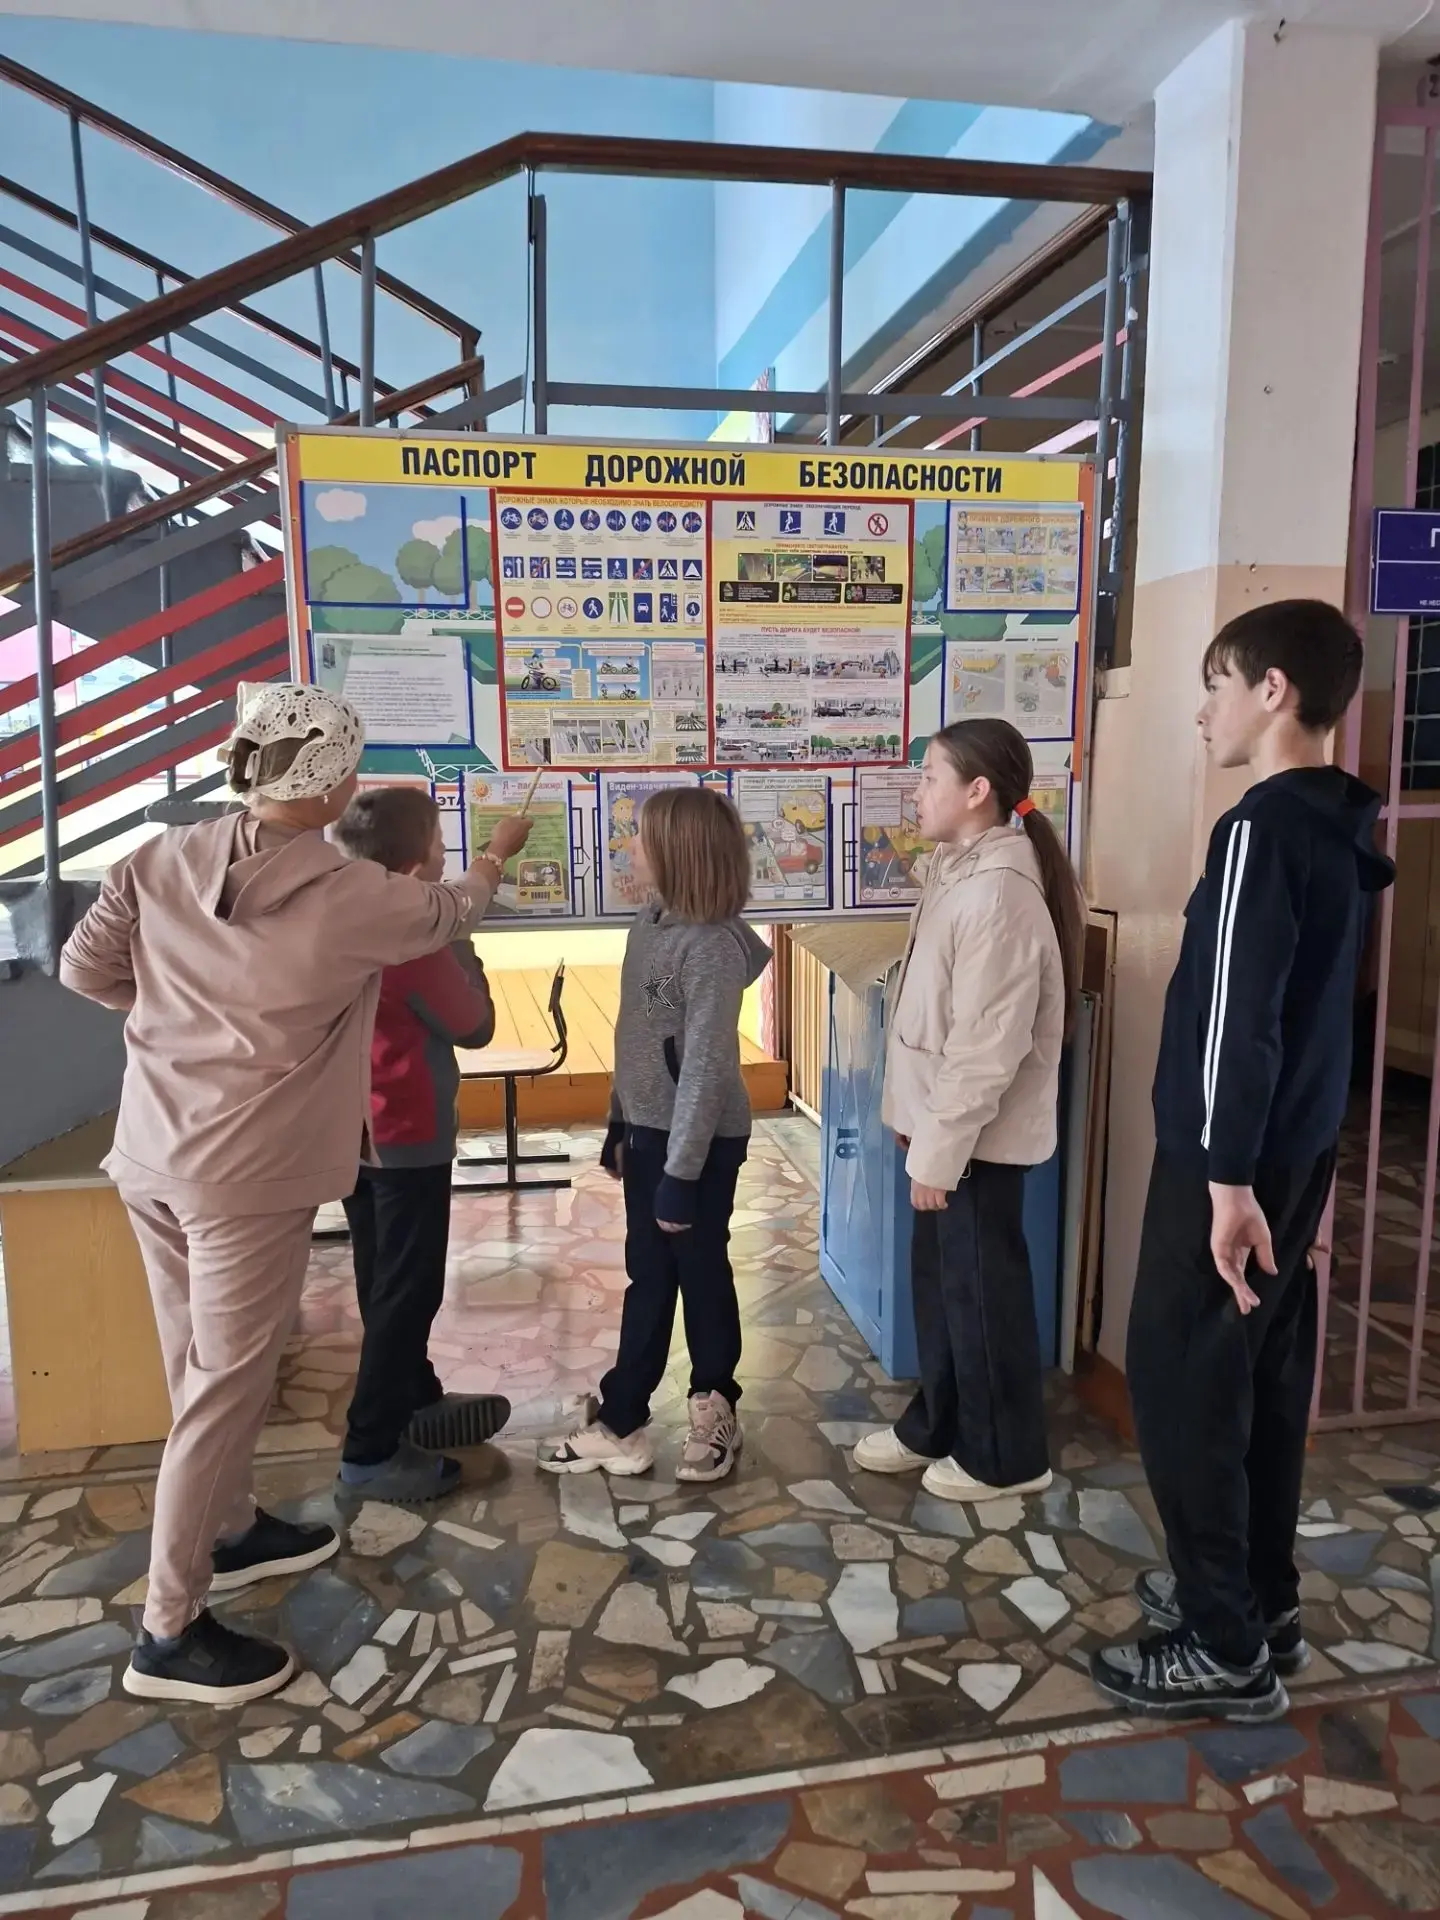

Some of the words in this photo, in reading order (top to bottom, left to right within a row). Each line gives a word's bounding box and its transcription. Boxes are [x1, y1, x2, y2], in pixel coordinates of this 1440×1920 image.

[402, 447, 536, 479] ПАСПОРТ
[585, 453, 745, 487] ДОРОЖНОЙ
[799, 461, 1001, 492] БЕЗОПАСНОСТИ
[498, 496, 534, 504] ДОРОЖНЫЕ
[560, 497, 588, 505] КОТОРЫЕ
[591, 498, 631, 506] НЕОБХОДИМО
[633, 499, 651, 507] ЗНАТЬ
[653, 500, 704, 508] ВЕЛОСИПЕДИСТУ
[502, 781, 509, 790] Я
[517, 781, 563, 791] пасажир!
